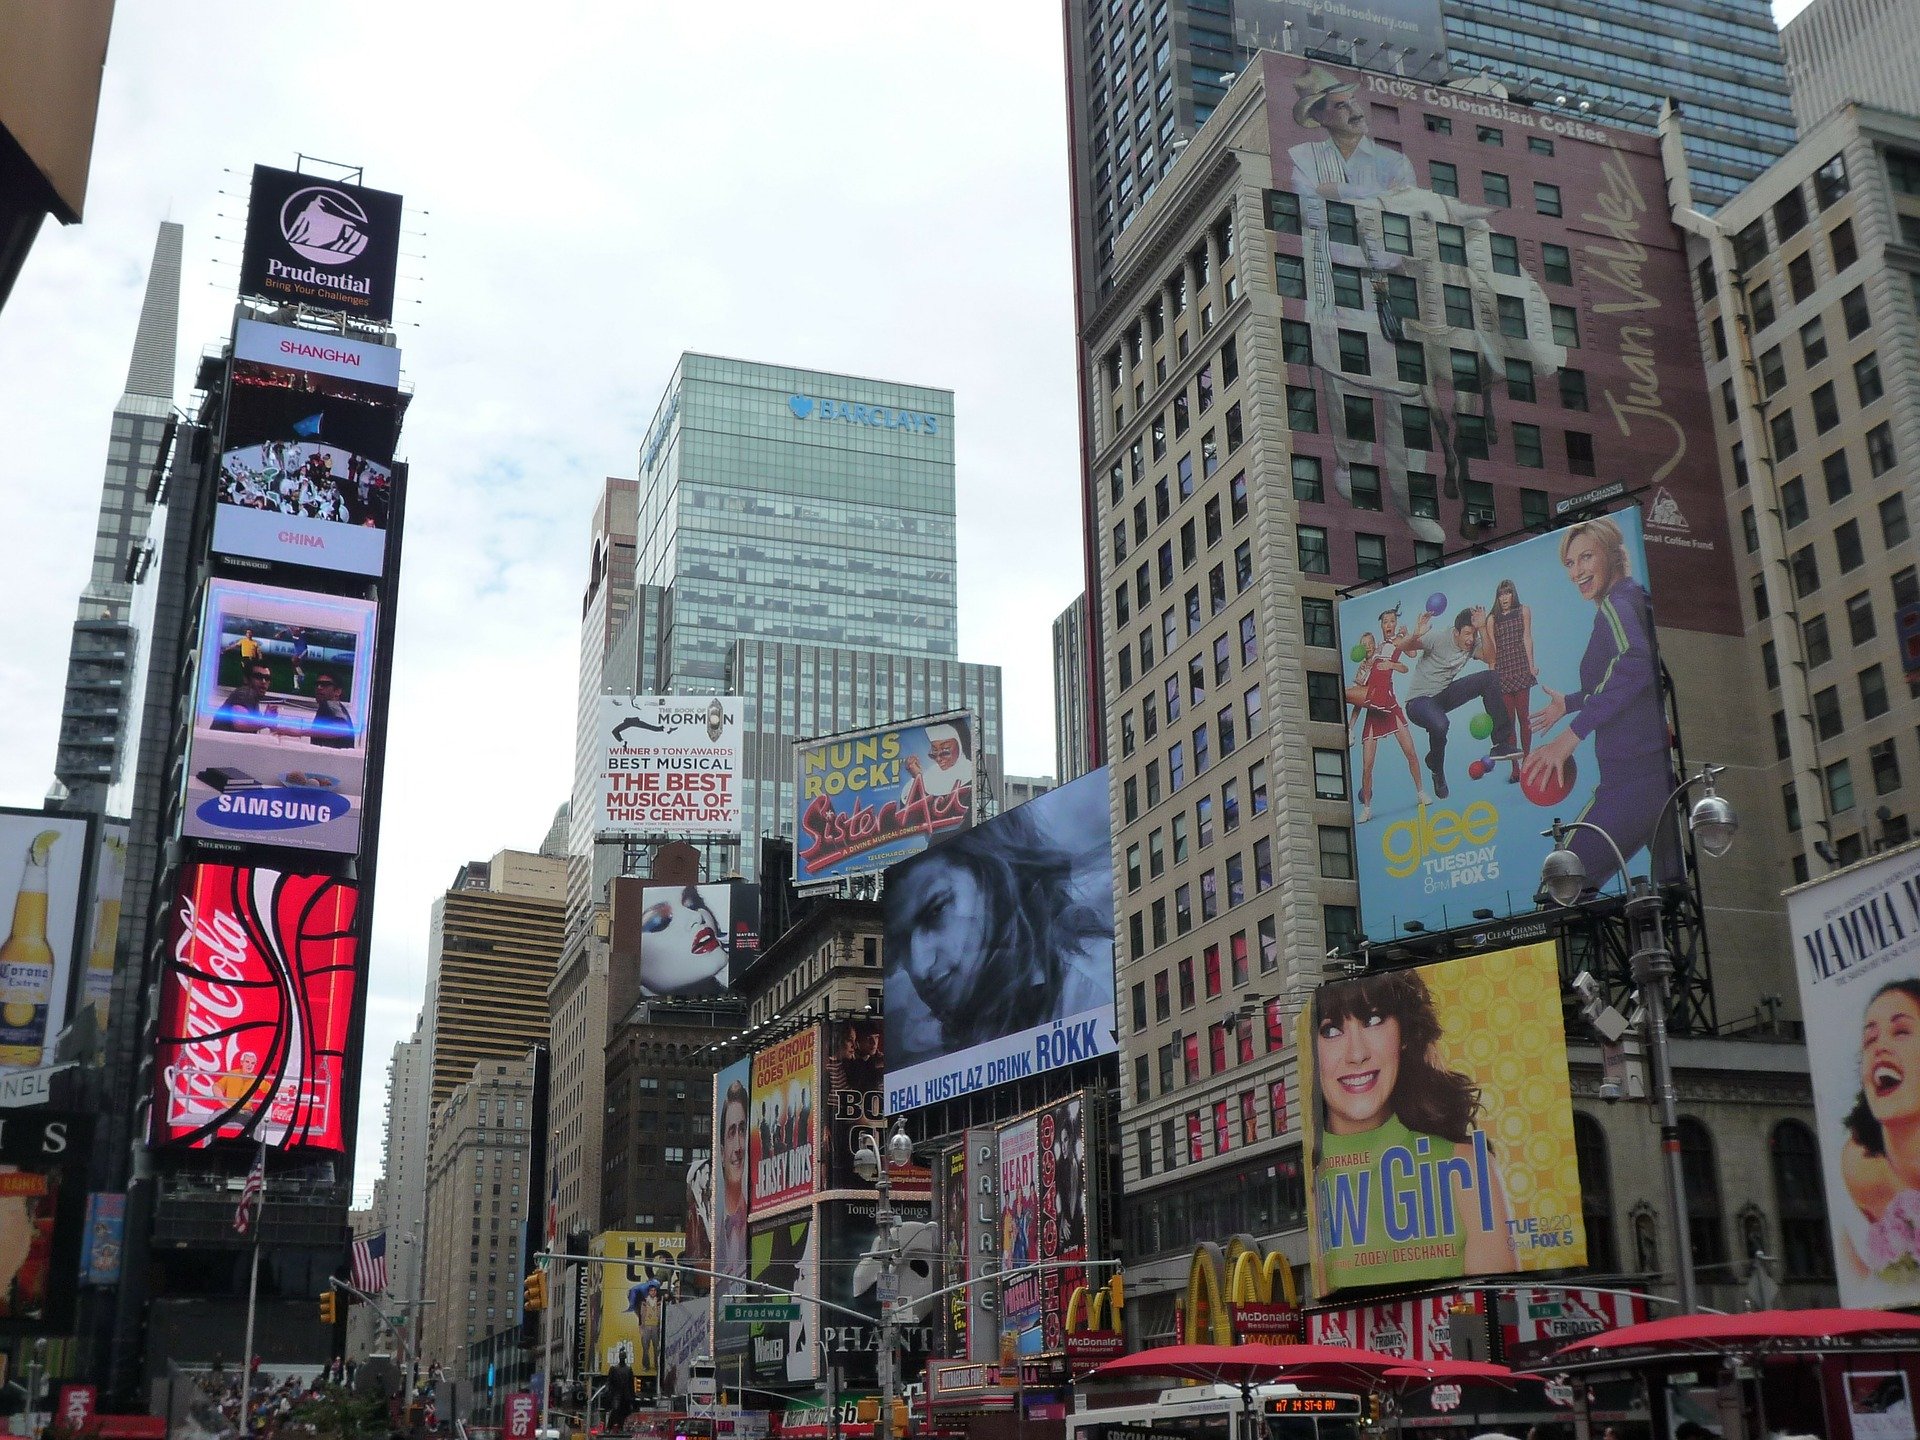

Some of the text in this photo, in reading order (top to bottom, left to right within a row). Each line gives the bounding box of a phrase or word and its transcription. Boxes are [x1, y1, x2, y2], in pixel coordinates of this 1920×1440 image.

[1367, 76, 1608, 143] 100% Colombian Coffee
[267, 258, 371, 295] Prudential
[265, 278, 370, 306] Bring Your Challenges
[1582, 142, 1688, 484] Juan Valdez
[280, 340, 360, 366] SHANGHAI
[820, 400, 939, 434] BARCLAYS
[278, 530, 325, 549] CHINA
[1664, 536, 1691, 546] Coffee
[1692, 539, 1714, 550] Fund
[224, 556, 269, 570] SHERWOOD
[608, 758, 733, 770] BEST MUSICAL
[609, 747, 733, 756] WINNER 9 TONY AWARDS
[804, 732, 901, 774] NUNS
[666, 774, 733, 791] BEST
[217, 794, 331, 823] SAMSUNG
[606, 792, 732, 807] MUSICAL OF
[606, 808, 646, 821] THIS
[799, 773, 972, 860] Sister Act
[198, 839, 241, 851] SHERWOOD
[849, 840, 872, 853] DIVINE
[872, 830, 898, 843] MUSICAL
[1382, 800, 1498, 878] glee
[1423, 846, 1497, 875] TUESDAY
[1424, 862, 1500, 894] 8PM FOX 5
[1803, 891, 1905, 984] MAMMA
[758, 1031, 815, 1072] THE CROWD
[757, 1065, 784, 1088] GOES
[785, 1052, 813, 1077] WILD!
[890, 1019, 1099, 1113] REAL HUSTLAZ DRINK RÖKK
[756, 1151, 789, 1199] JERSEY
[788, 1143, 813, 1190] BOYS
[1002, 1151, 1035, 1194] HEART
[1379, 1129, 1495, 1244] Girl
[846, 1203, 878, 1218] Tonig
[978, 1147, 996, 1310] PALACE
[1505, 1214, 1572, 1235] TUE 9/20
[1531, 1232, 1561, 1249] FOX
[1563, 1229, 1574, 1245] 5
[1354, 1249, 1389, 1267] ZOOEY
[1392, 1243, 1458, 1263] DESCHANEL
[735, 1308, 789, 1319] Broadway
[1237, 1312, 1299, 1322] McDonald's
[1375, 1332, 1403, 1348] FRIDAYS
[1553, 1320, 1601, 1336] FRIDAYS
[1068, 1338, 1123, 1346] McDonald's
[512, 1397, 532, 1436] tkts
[1292, 1401, 1302, 1412] 14
[1304, 1401, 1323, 1411] ST-6
[1325, 1400, 1336, 1411] AV
